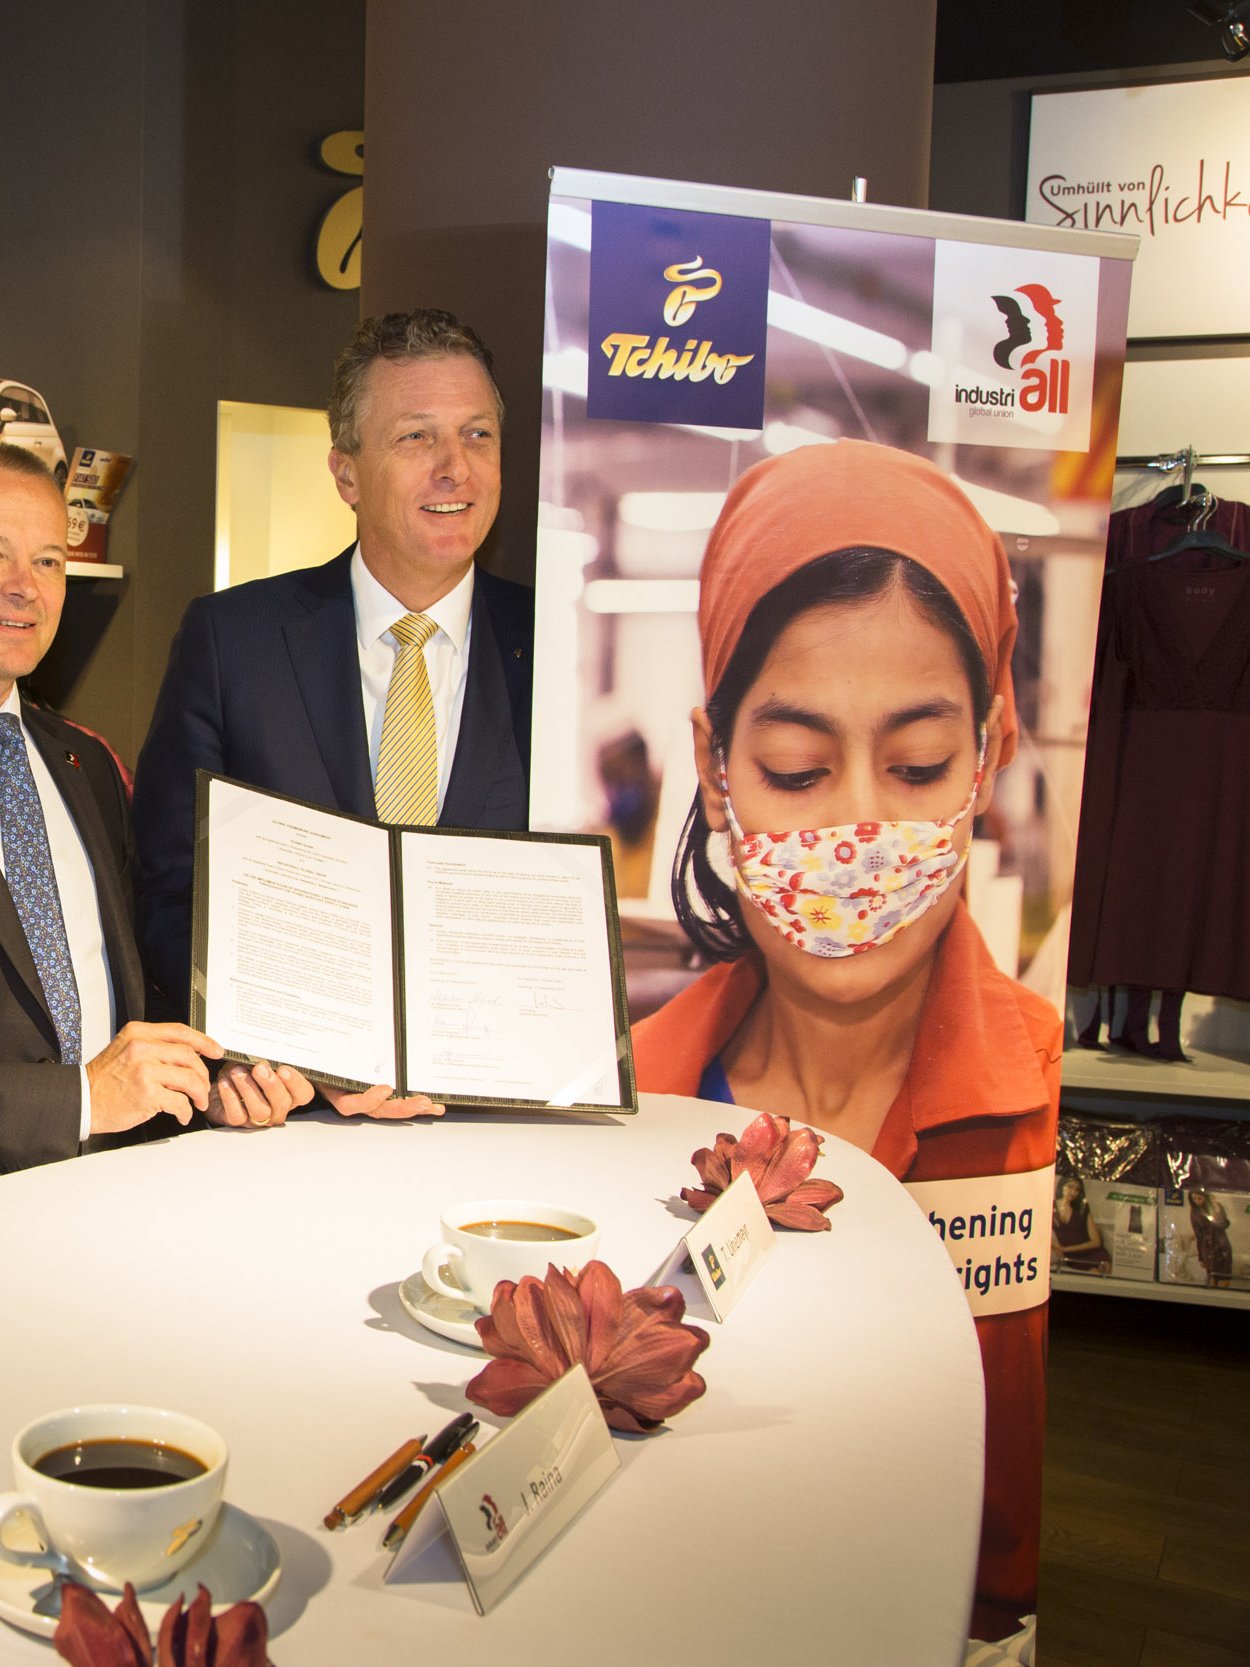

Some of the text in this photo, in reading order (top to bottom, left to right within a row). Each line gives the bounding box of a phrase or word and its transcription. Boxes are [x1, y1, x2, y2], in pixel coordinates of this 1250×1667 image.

[1039, 159, 1250, 237] Sinnlichk
[1050, 181, 1145, 197] Umhüllt von
[601, 333, 755, 385] Tchibo
[955, 384, 1015, 407] industri
[1019, 358, 1070, 415] all
[968, 407, 1015, 418] global union
[928, 1205, 1033, 1241] hening
[530, 1466, 563, 1505] Raina
